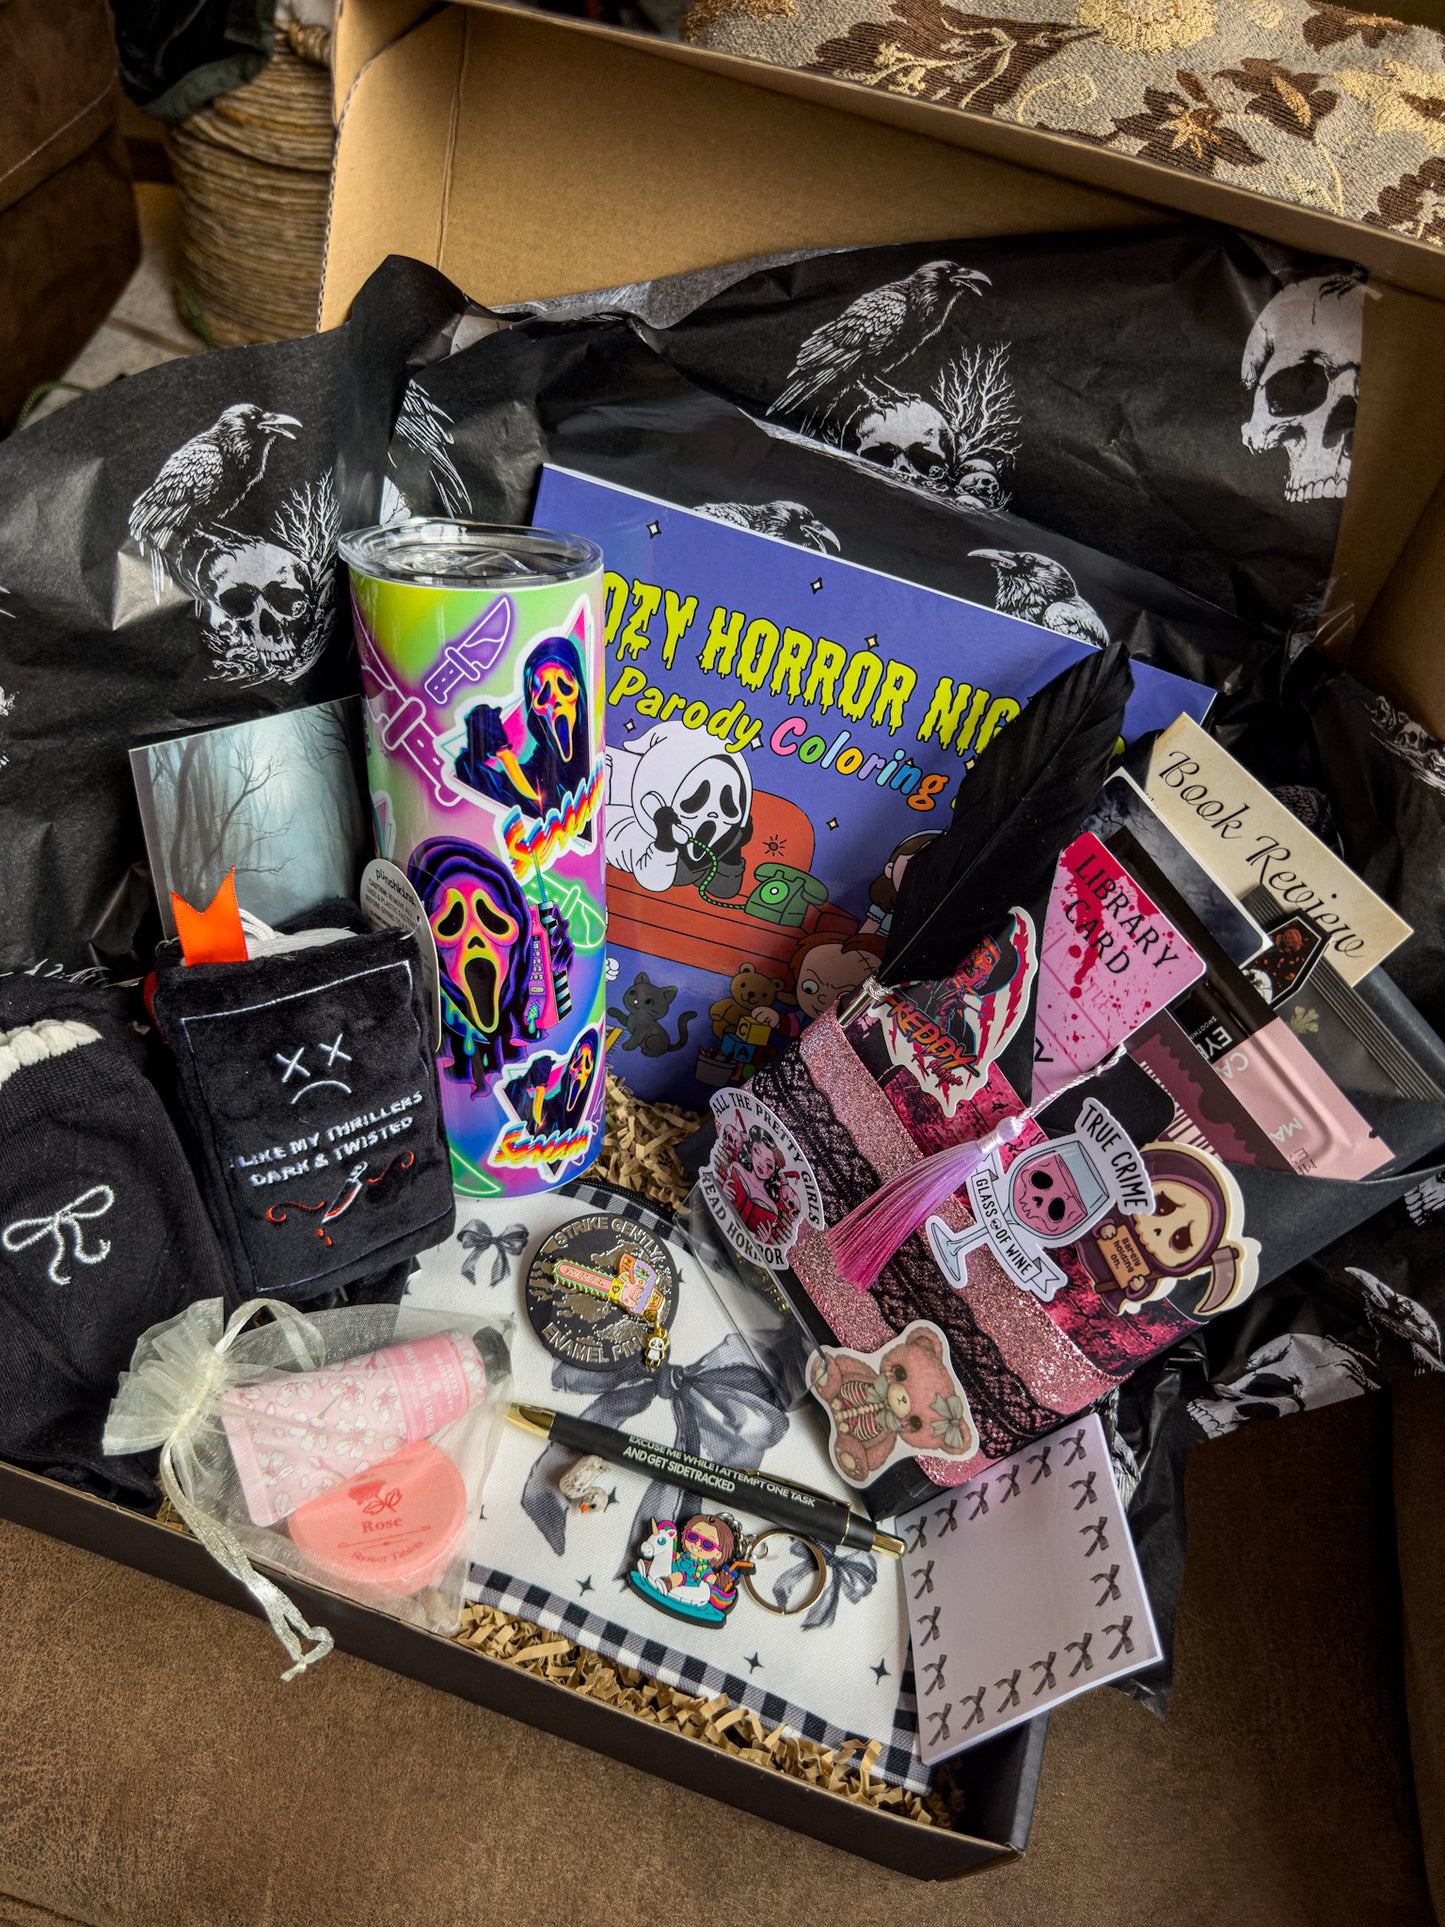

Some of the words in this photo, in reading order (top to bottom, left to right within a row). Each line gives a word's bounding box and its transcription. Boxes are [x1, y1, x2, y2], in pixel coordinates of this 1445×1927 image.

[604, 571, 698, 670] OZY
[702, 607, 917, 736] HORROR
[916, 676, 1021, 757] NIG
[609, 666, 763, 753] Parody
[770, 717, 950, 811] Coloring
[1159, 751, 1250, 840] Book
[1245, 835, 1366, 958] Review
[1064, 900, 1130, 974] CARD
[1074, 854, 1179, 969] LIBRARY
[238, 1147, 286, 1168] LIKE
[291, 1132, 320, 1154] MY
[326, 1091, 423, 1142] THRILLERS
[250, 1159, 310, 1187] DARK
[314, 1153, 329, 1168] &
[333, 1116, 413, 1161] TWISTED
[713, 1094, 730, 1118] ALL
[729, 1093, 752, 1111] THE
[756, 1105, 804, 1163] PRETTY
[801, 1170, 820, 1226] GIRLS
[1079, 1103, 1115, 1153] TRUE
[1111, 1150, 1149, 1208] CRIME
[702, 1171, 727, 1221] READ
[975, 1178, 998, 1218] GLASS
[995, 1228, 1010, 1246] OF
[1005, 1244, 1034, 1276] WINE
[554, 1216, 609, 1246] STRIKE
[611, 1218, 666, 1262] GENTLY
[1110, 1254, 1120, 1269] on.
[1113, 1240, 1134, 1273] holding
[1122, 1237, 1141, 1267] Barely
[542, 1321, 609, 1363] ENAMEL
[612, 1336, 643, 1361] PIN
[623, 1445, 648, 1462] AND
[647, 1454, 668, 1469] GET
[667, 1460, 736, 1492] SIDETRACKED
[629, 1435, 666, 1454] EXCUSE
[666, 1448, 682, 1460] ME
[681, 1454, 715, 1472] WHILE
[719, 1466, 766, 1489] ATTEMPT
[766, 1483, 789, 1498] ONE
[790, 1490, 816, 1508] TASK
[352, 1551, 387, 1562] Shower
[362, 1517, 402, 1533] Rose
